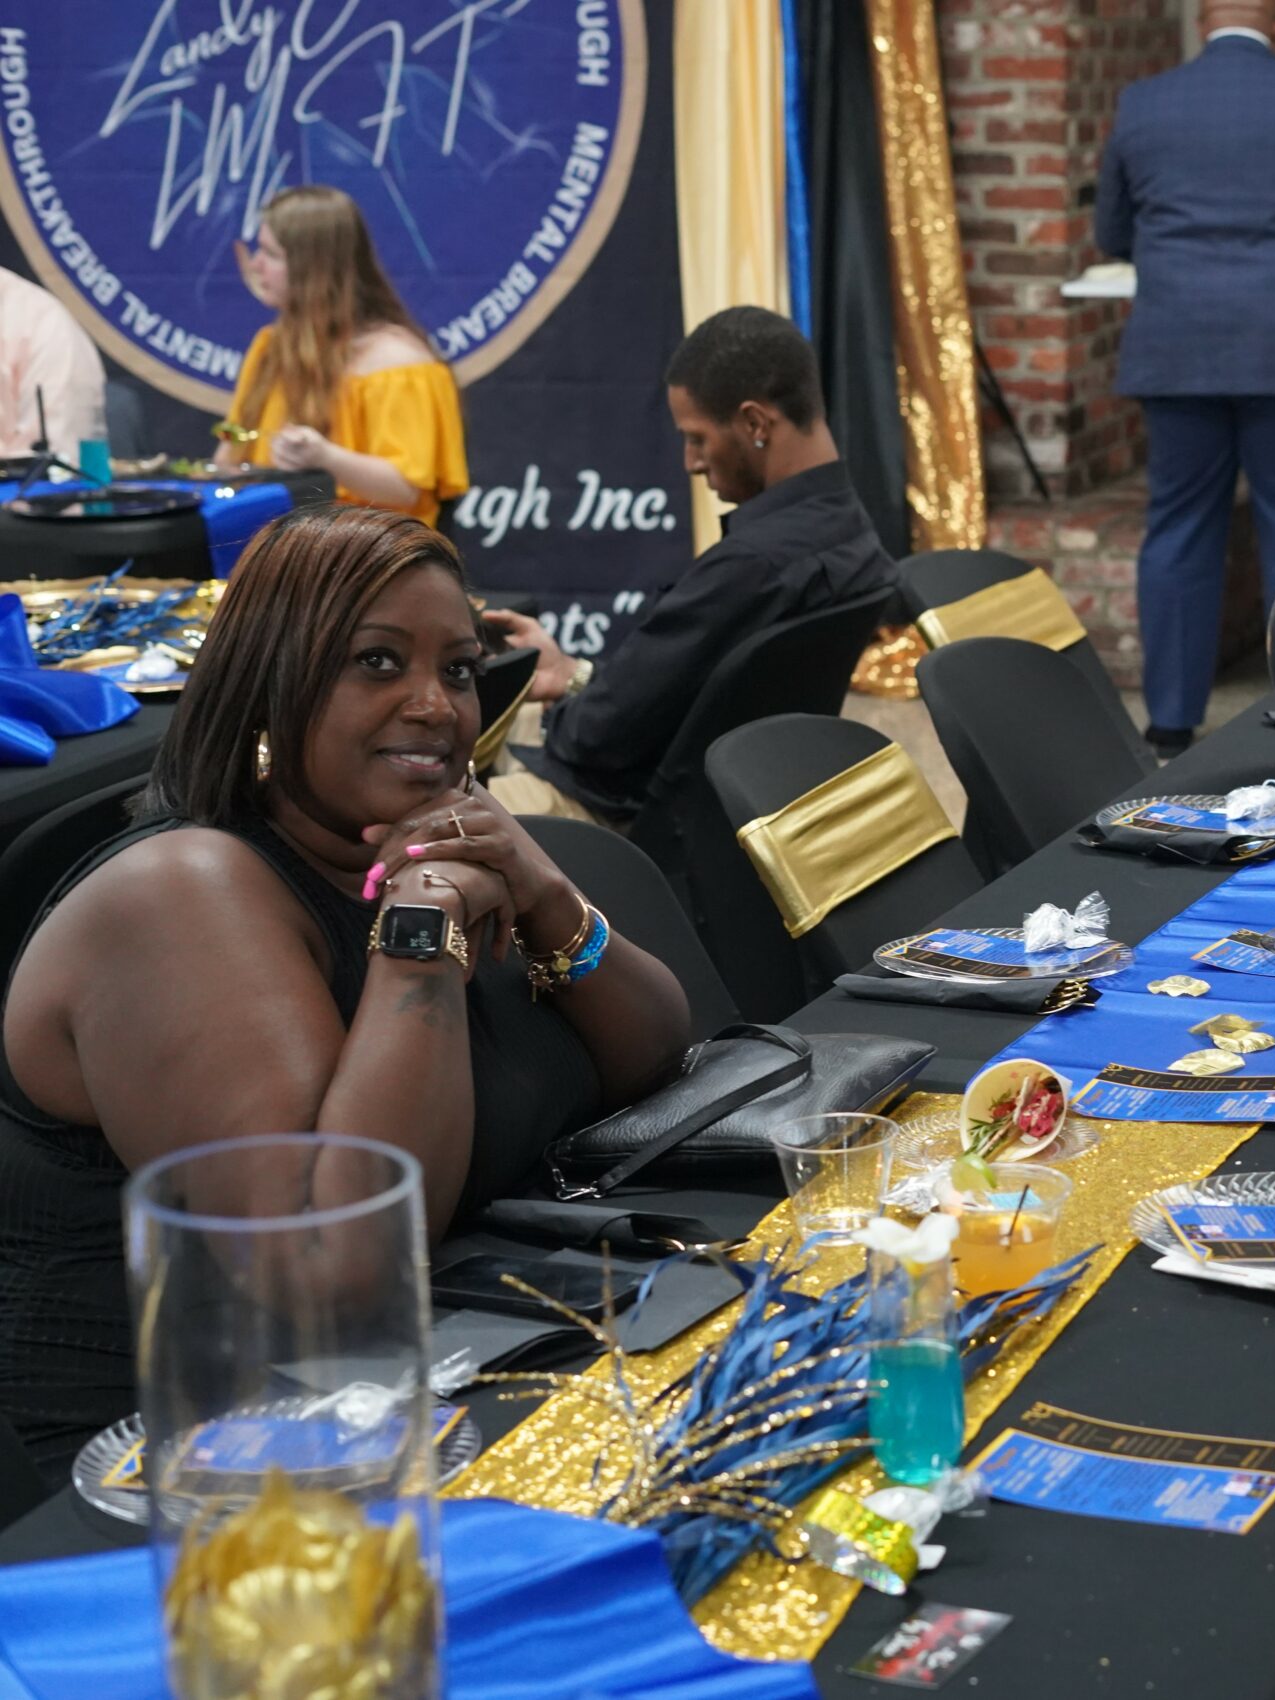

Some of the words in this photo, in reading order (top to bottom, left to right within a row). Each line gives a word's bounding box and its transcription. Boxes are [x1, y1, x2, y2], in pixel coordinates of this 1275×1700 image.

[574, 0, 612, 87] UGH
[1, 26, 123, 306] BREAKTHROUGH
[522, 121, 609, 263] MENTAL
[120, 290, 245, 381] MENTAL
[567, 468, 677, 531] Inc.
